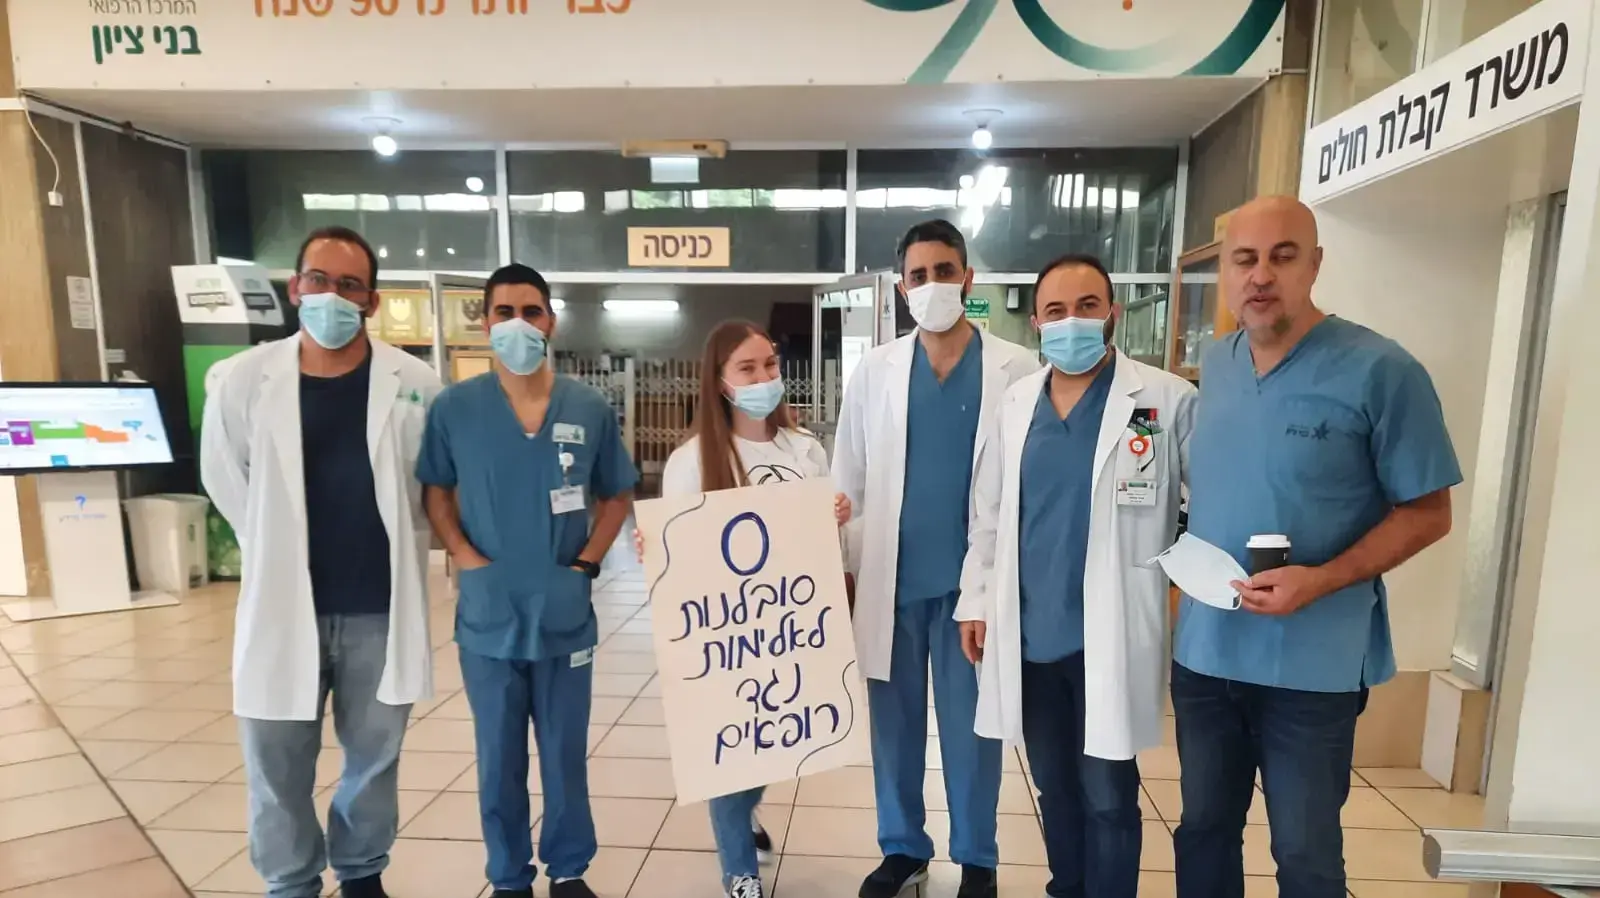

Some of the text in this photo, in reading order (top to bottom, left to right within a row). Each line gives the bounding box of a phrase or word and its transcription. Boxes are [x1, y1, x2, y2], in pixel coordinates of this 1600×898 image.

[92, 25, 202, 64] בני ציון
[1318, 22, 1569, 184] משרד קבלת חולים
[643, 234, 712, 258] כניסה
[721, 511, 770, 576] 0
[670, 575, 815, 642] סובלנות
[683, 606, 832, 680] לאלימות
[736, 663, 801, 713] נגד
[715, 703, 839, 765] רופאים
